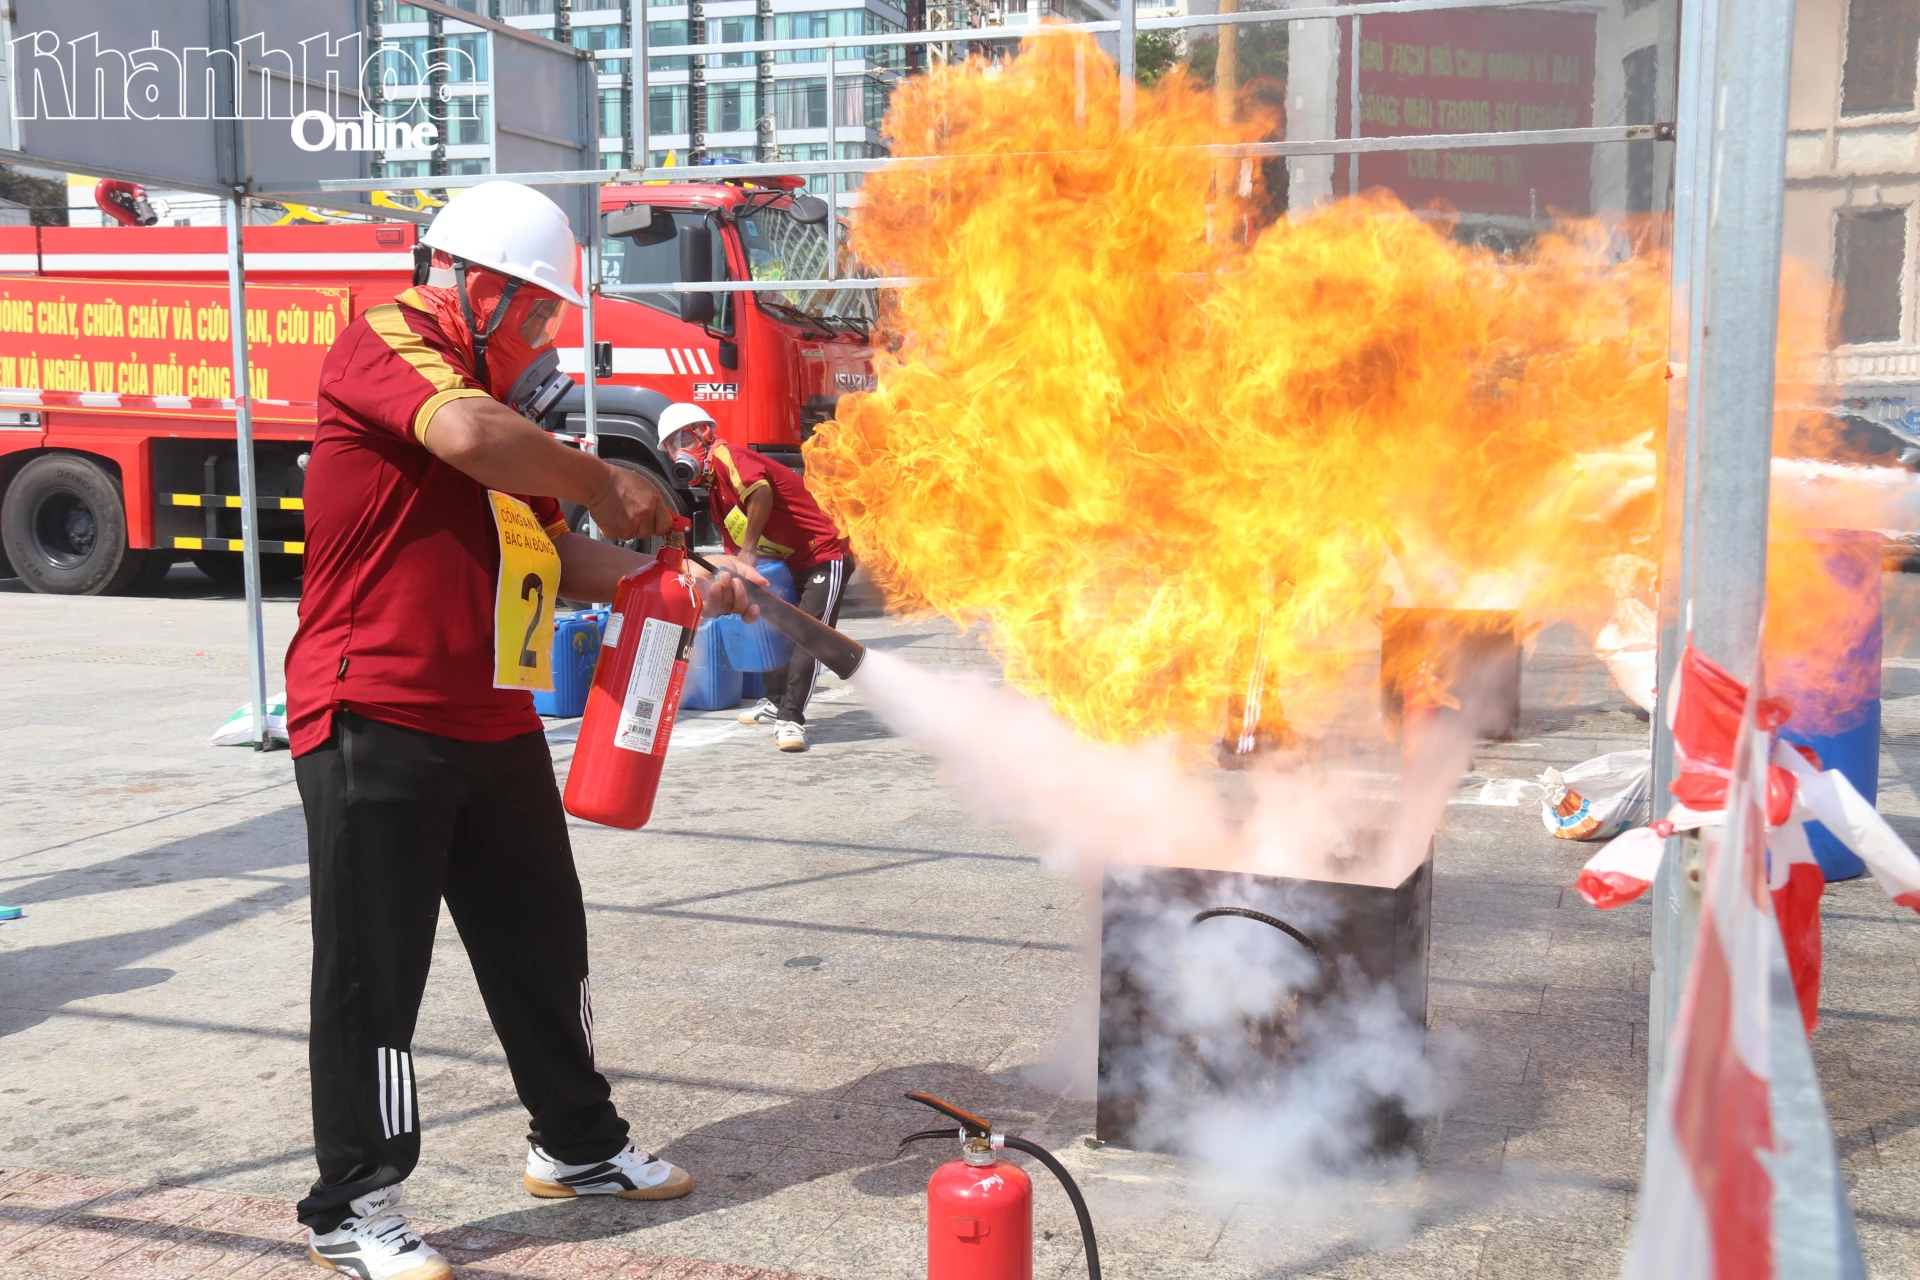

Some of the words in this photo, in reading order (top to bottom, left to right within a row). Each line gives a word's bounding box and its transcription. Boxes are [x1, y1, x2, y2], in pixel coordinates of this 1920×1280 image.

[1360, 31, 1385, 72] HỦ
[0, 291, 34, 334] ÒNG
[37, 295, 80, 341] CHÁY,
[82, 297, 125, 338] CHỮA
[127, 298, 170, 340] CHÁY
[172, 299, 194, 341] VÀ
[197, 300, 230, 343] CỨU
[246, 308, 273, 351] ẠN,
[276, 302, 310, 345] CỨU
[313, 303, 337, 353] HỘ
[19, 350, 41, 390] VÀ
[43, 353, 91, 393] NGHĨA
[118, 351, 150, 396] CỦA
[153, 351, 184, 397] MỖI
[187, 358, 231, 399] CÔNG
[248, 360, 269, 400] ÂN
[693, 392, 738, 401] 300
[694, 383, 737, 392] FVR
[518, 572, 544, 669] 2
